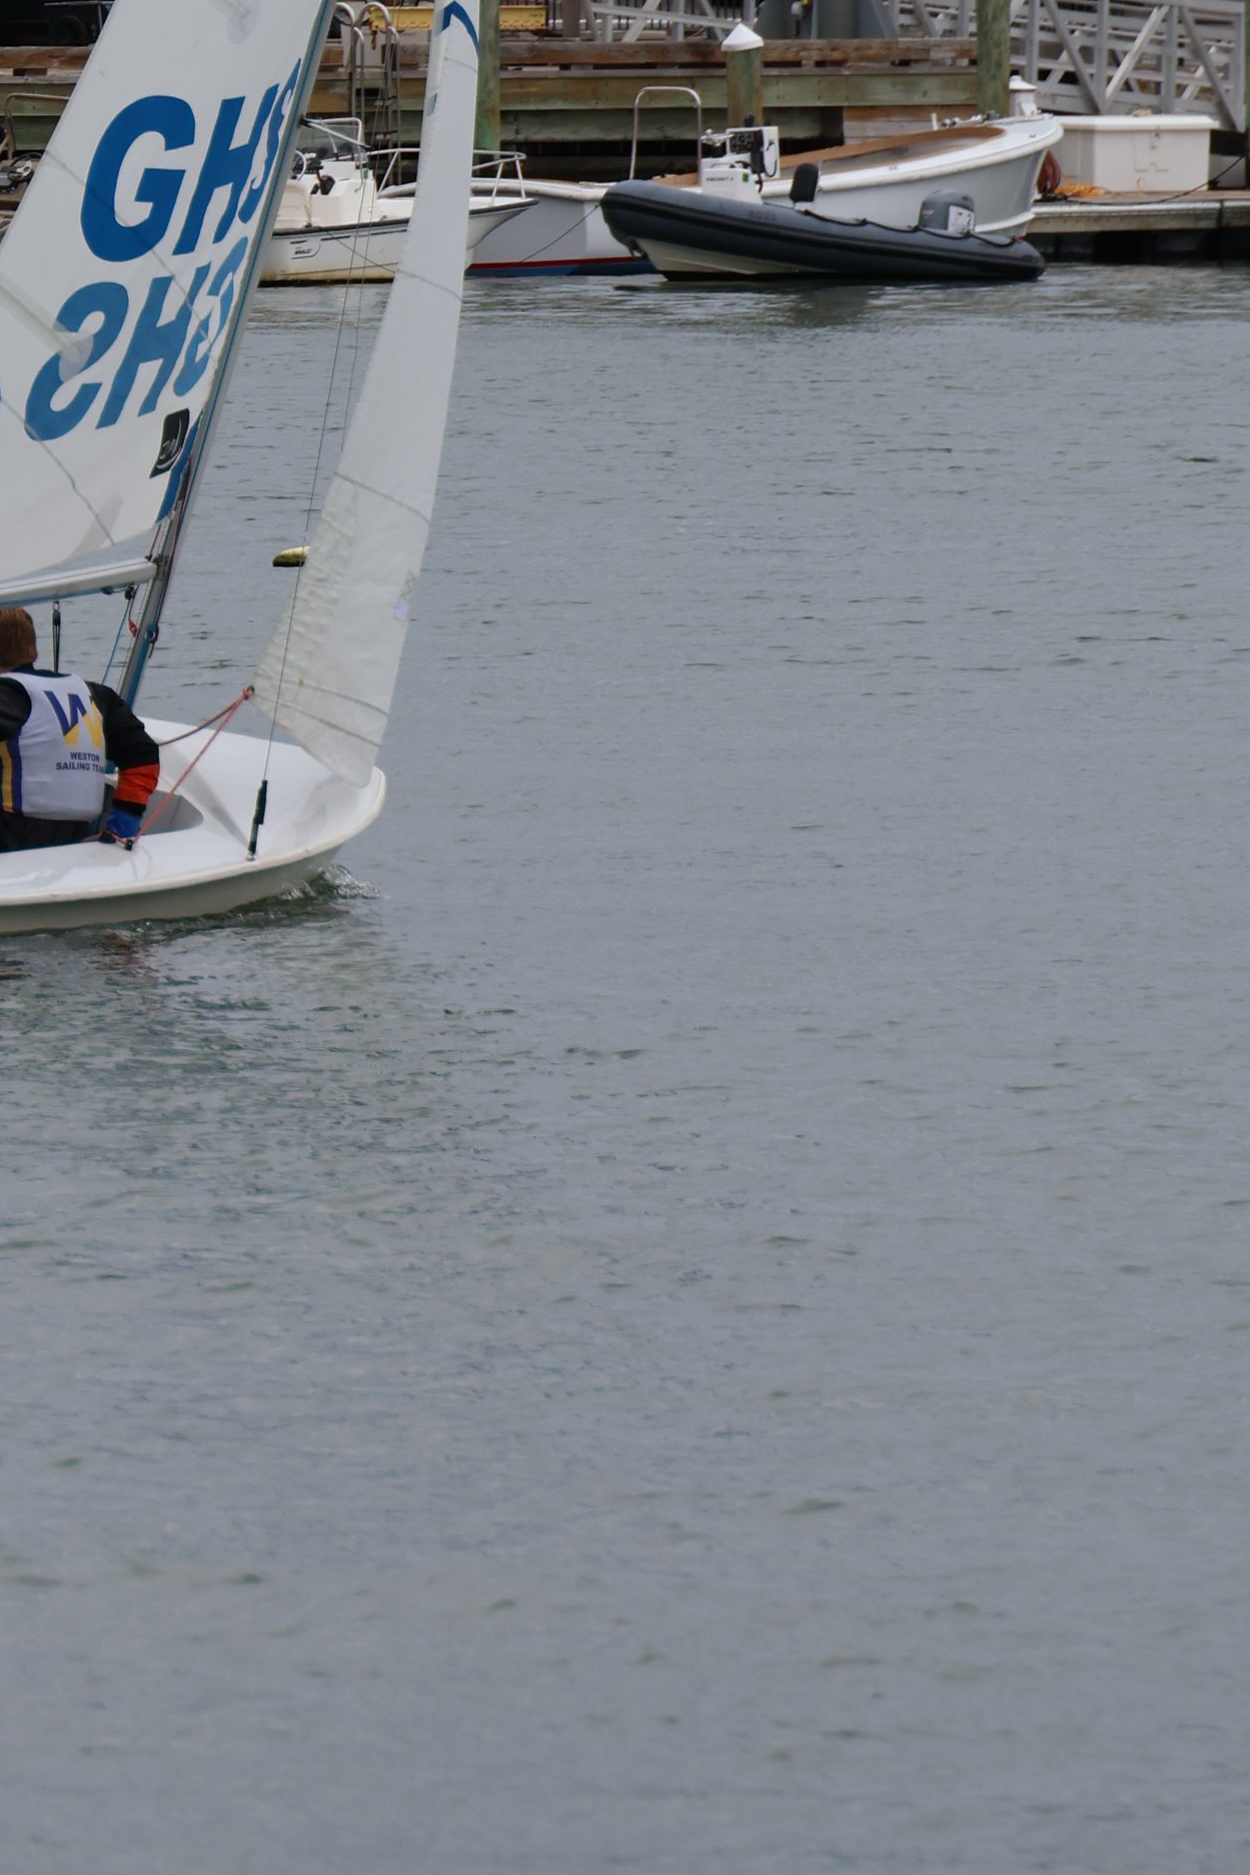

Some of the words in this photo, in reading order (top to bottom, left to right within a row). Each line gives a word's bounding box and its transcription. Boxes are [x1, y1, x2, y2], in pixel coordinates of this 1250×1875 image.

[80, 57, 302, 263] GHS
[70, 752, 100, 762] WESTON
[55, 761, 90, 771] SAILING
